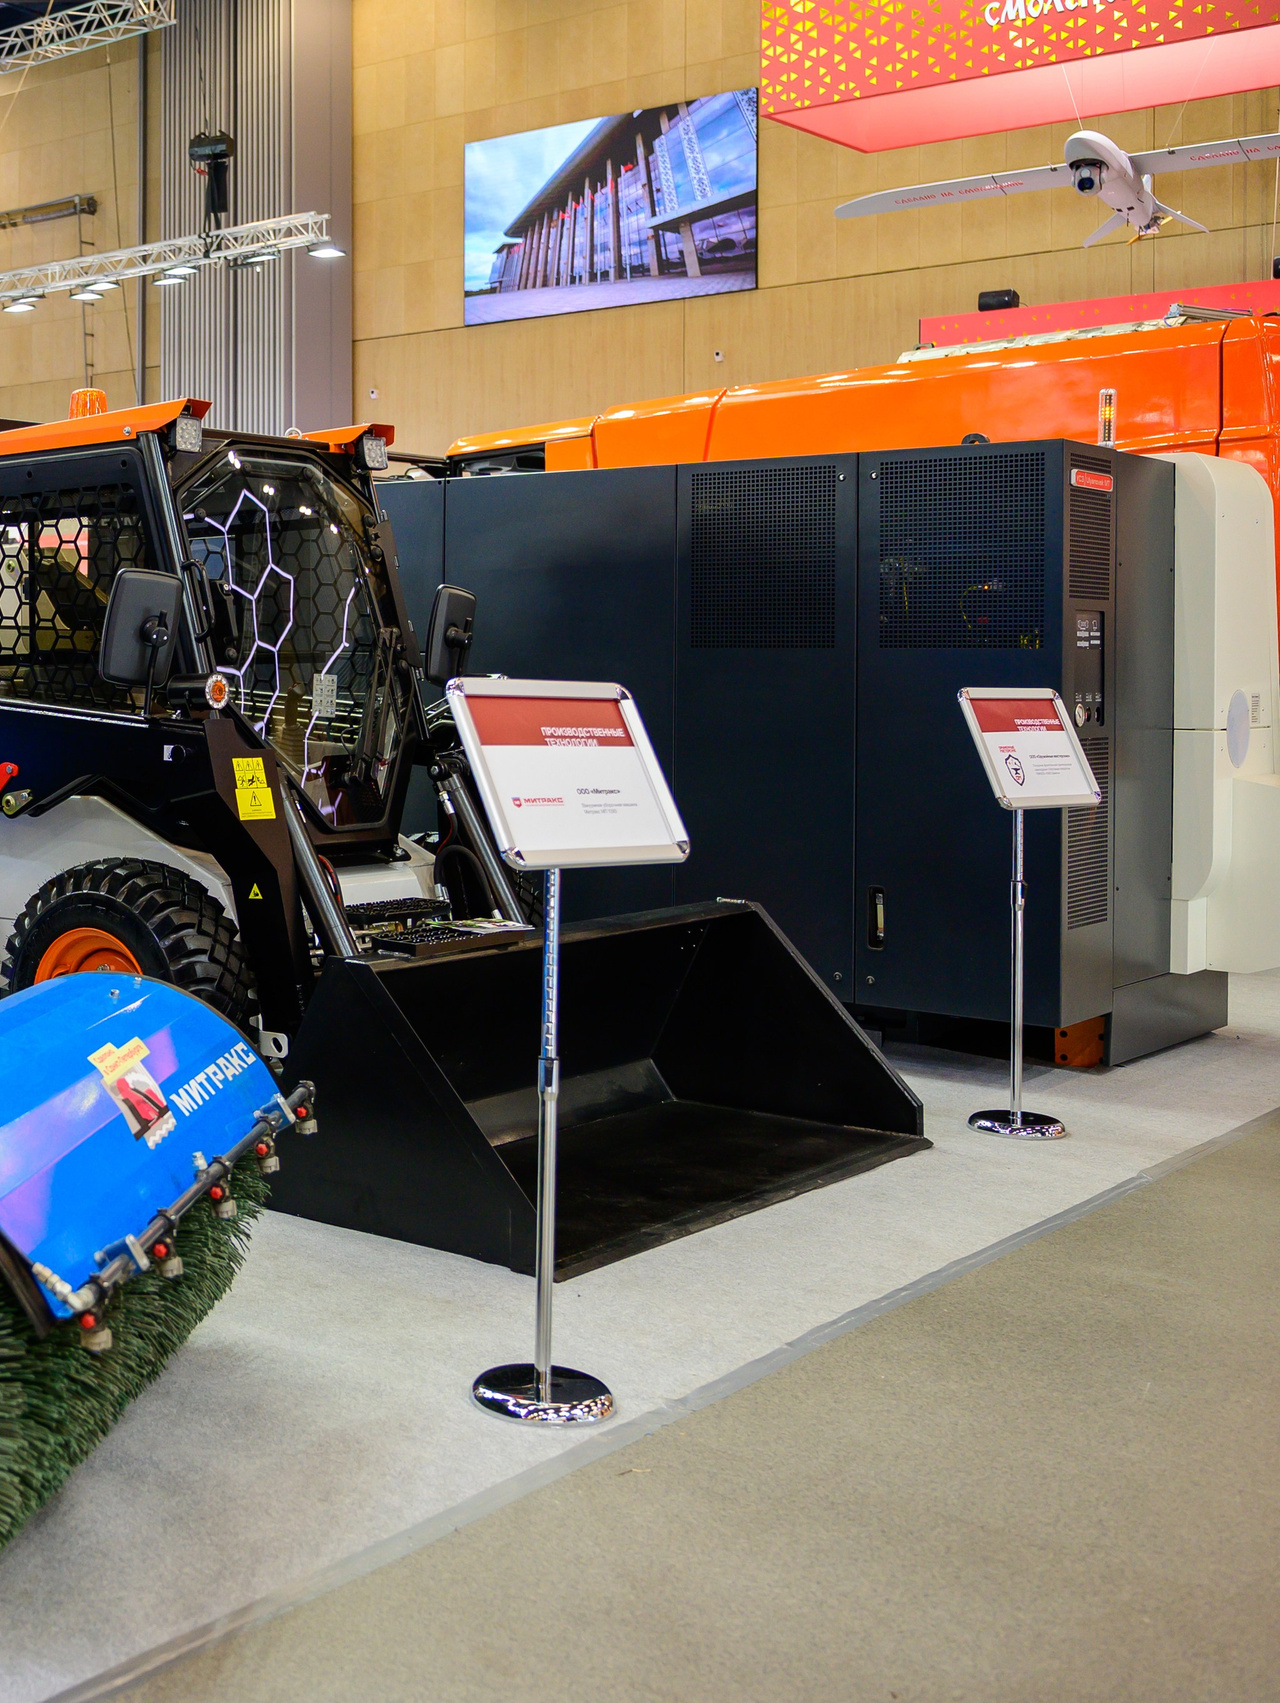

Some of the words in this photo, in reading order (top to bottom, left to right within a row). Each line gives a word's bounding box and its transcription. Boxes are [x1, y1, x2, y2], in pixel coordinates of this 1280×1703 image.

[540, 727, 625, 738] ПРОИЗВОДСТВЕННЫЕ
[545, 738, 599, 747] ТЕХНОЛОГИИ
[590, 788, 621, 796] «Митракс»
[169, 1041, 257, 1118] МИТРАКС
